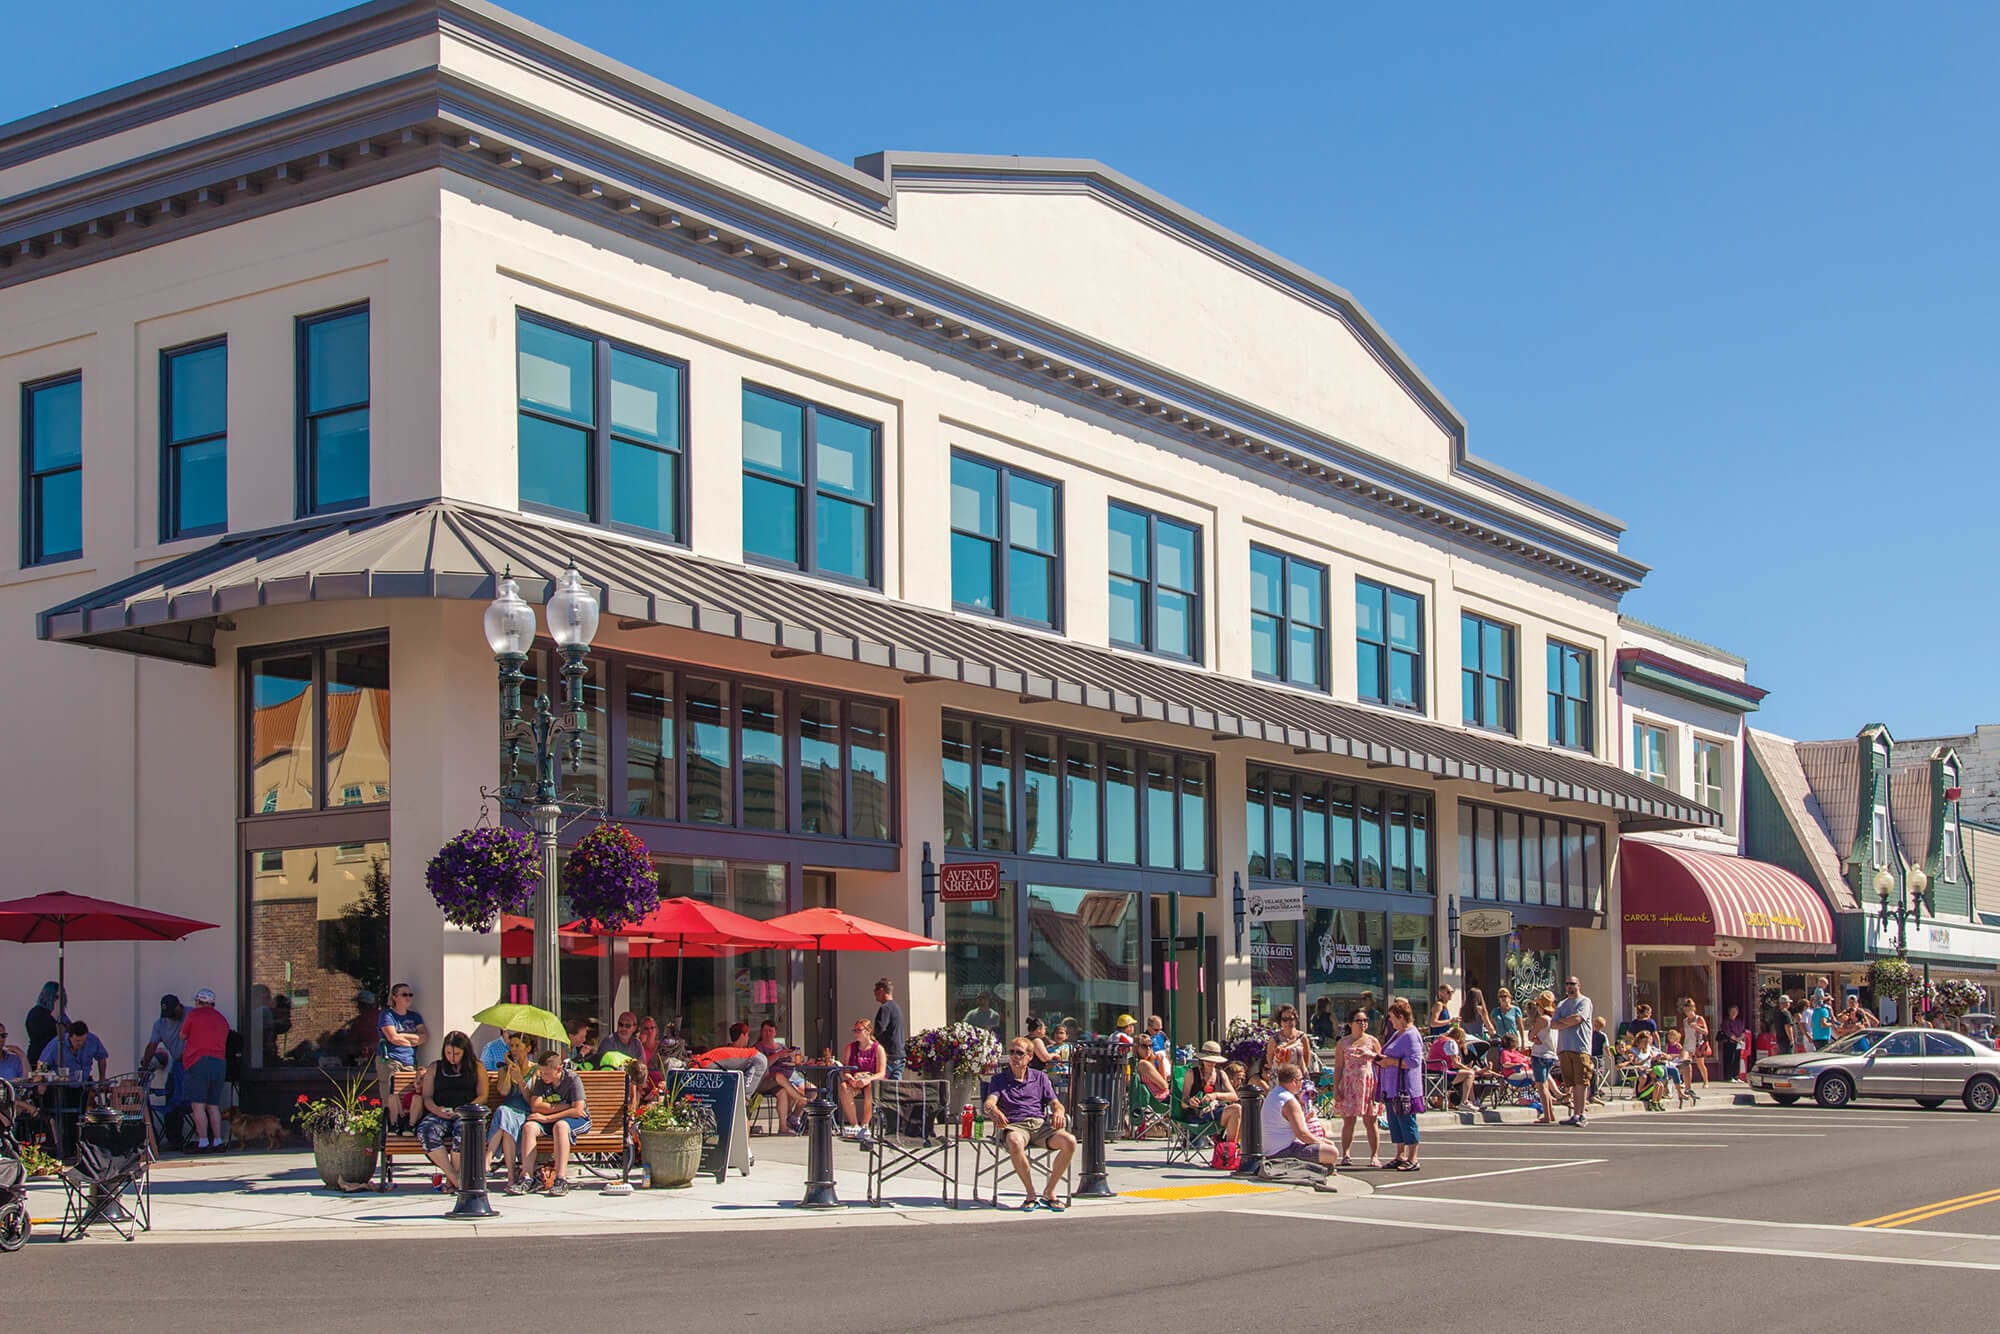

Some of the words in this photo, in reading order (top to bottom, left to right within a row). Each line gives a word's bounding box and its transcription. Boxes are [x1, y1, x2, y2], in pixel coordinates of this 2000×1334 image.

[946, 869, 992, 881] AVENUE
[948, 880, 991, 892] BREAD
[1623, 913, 1657, 922] CAROL'S
[1659, 911, 1711, 928] Hallmark
[1270, 946, 1276, 956] &
[1275, 946, 1293, 957] GIFTS
[1335, 943, 1355, 952] VILLAGE
[1394, 952, 1412, 962] CARDS
[684, 1072, 722, 1082] AVENUE
[685, 1079, 721, 1089] BREAD
